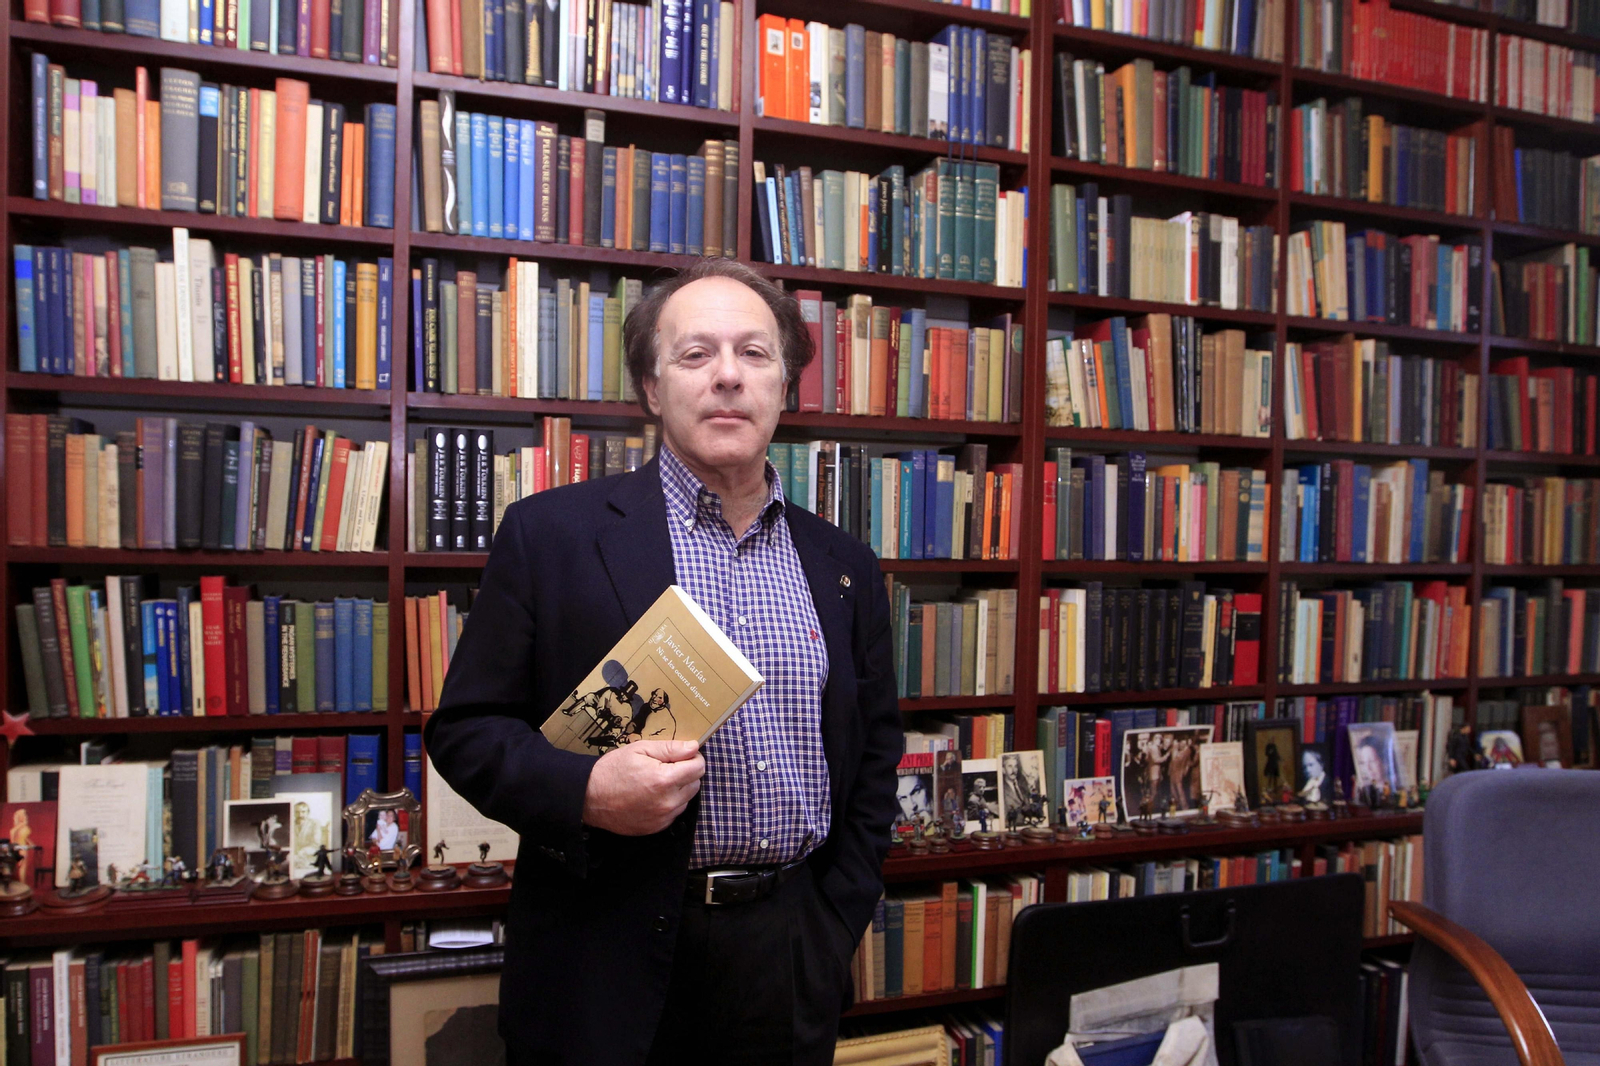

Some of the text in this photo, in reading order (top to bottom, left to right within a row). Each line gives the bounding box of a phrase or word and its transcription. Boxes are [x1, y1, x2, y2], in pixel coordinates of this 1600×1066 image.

[541, 138, 551, 222] PLEASURE OF RUINS
[880, 198, 888, 214] Joyce
[438, 466, 446, 498] TOLKIEN
[459, 467, 467, 499] TOLKIEN
[480, 467, 488, 500] TOLKIEN
[495, 472, 503, 506] HOBBIT
[281, 624, 288, 632] IN
[281, 644, 289, 688] RENAISSANCE
[288, 645, 296, 680] MYSTERIES
[663, 634, 708, 684] Javier Marías
[656, 645, 665, 657] Ni
[662, 655, 670, 663] se
[667, 659, 676, 671] les
[674, 668, 692, 688] ocurra
[689, 684, 712, 709] disparar
